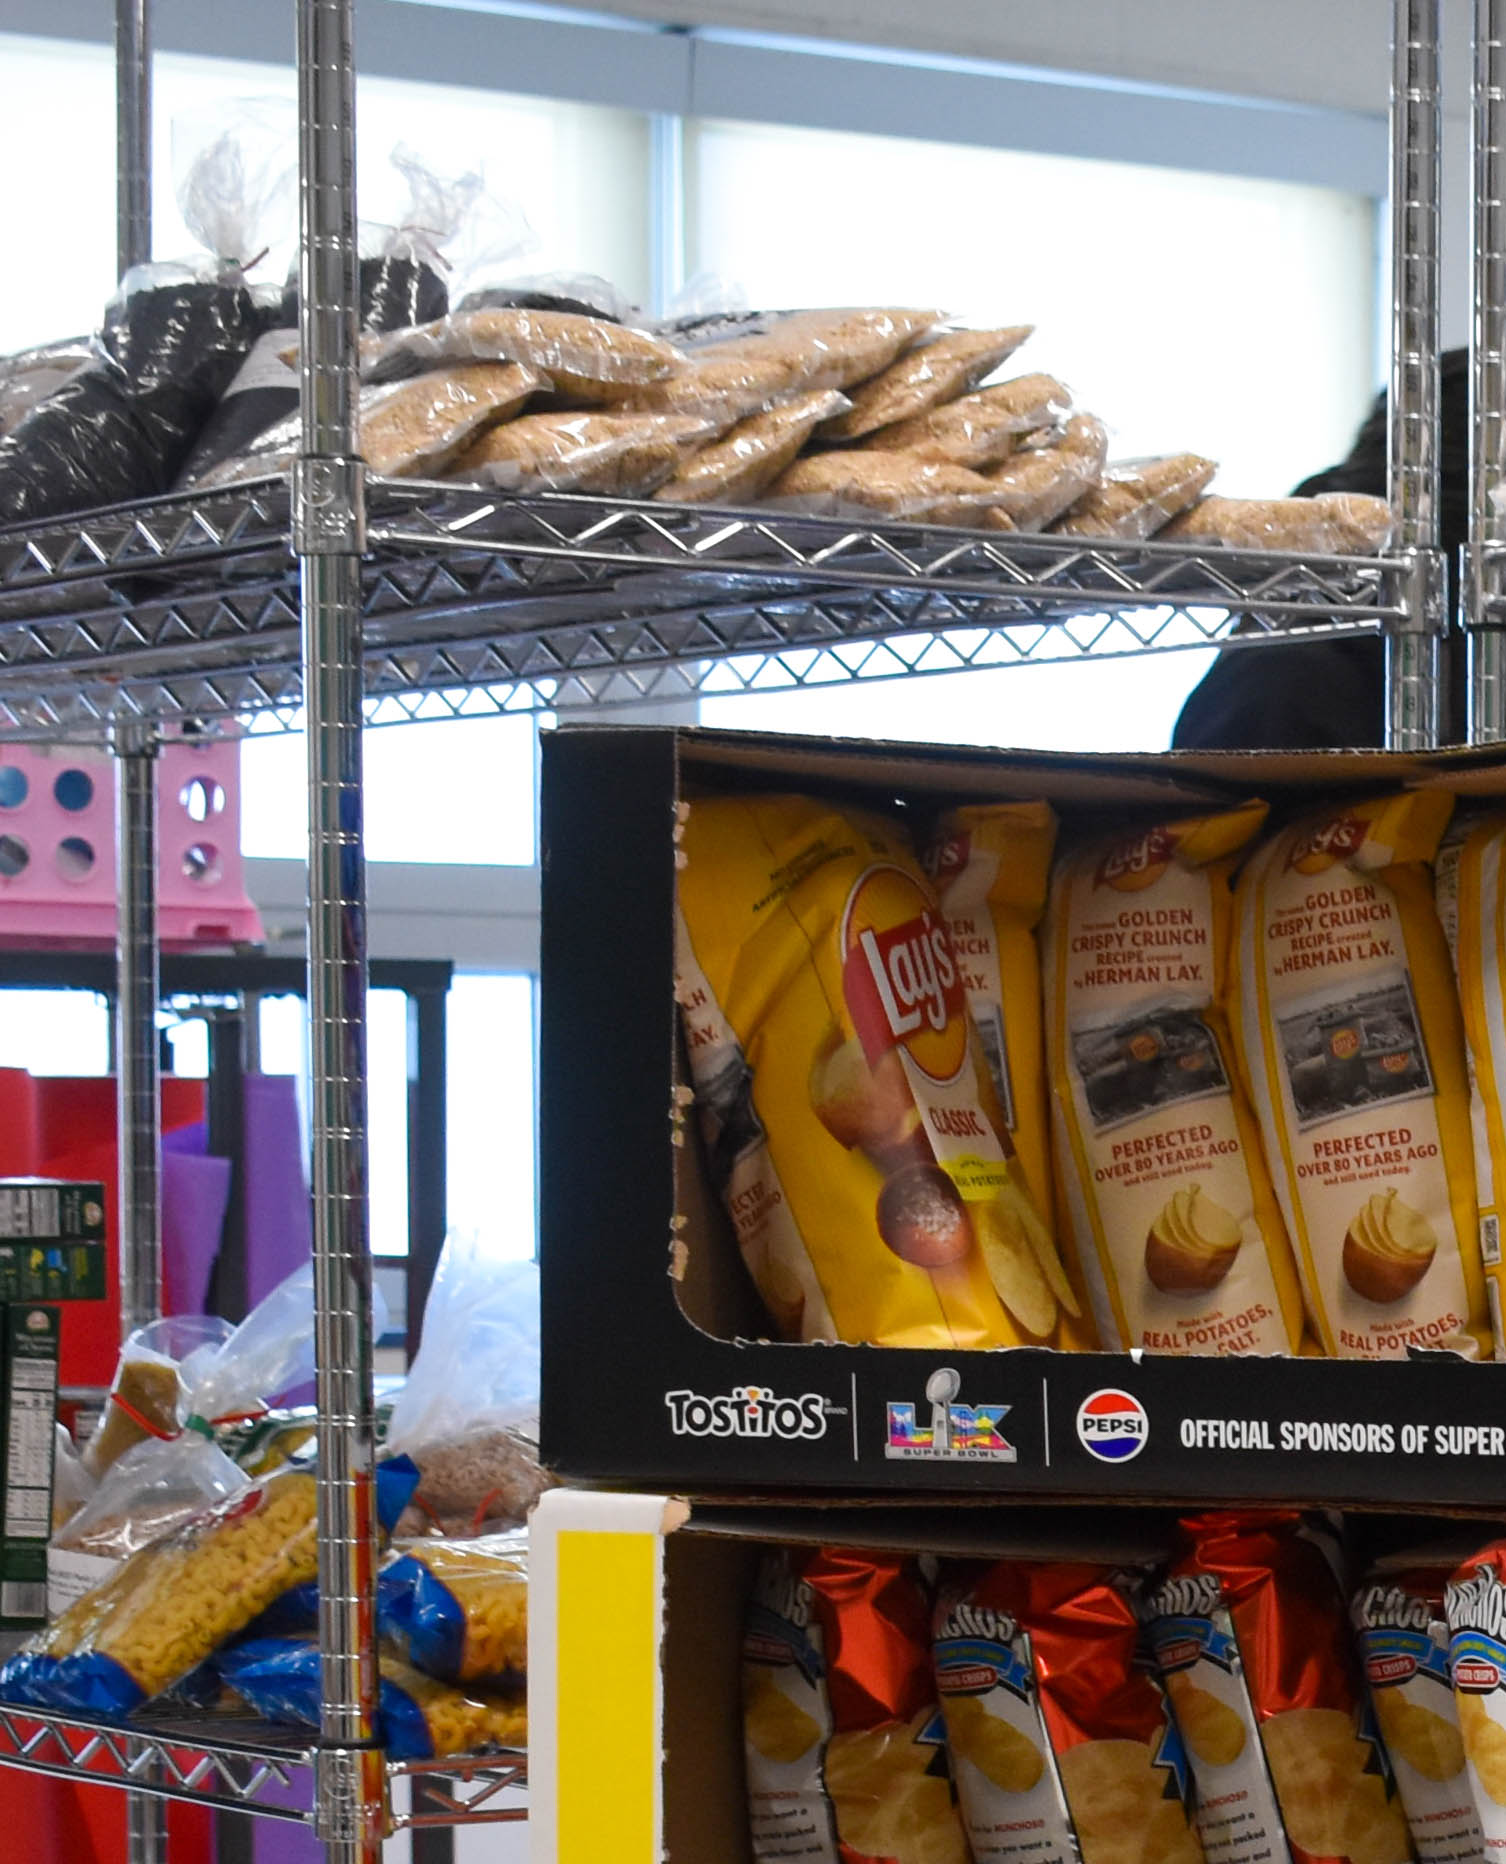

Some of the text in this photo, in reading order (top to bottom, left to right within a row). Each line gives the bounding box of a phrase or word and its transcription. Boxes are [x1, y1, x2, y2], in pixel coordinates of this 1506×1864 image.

[1305, 885, 1376, 911] GOLDEN
[1119, 908, 1193, 928] GOLDEN
[1268, 904, 1392, 940] CRISPY CRUNCH
[1071, 929, 1208, 953] CRISPY CRUNCH
[1282, 940, 1394, 973] HERMAN LAY.
[1291, 932, 1333, 952] RECIPE
[1096, 951, 1144, 965] RECIPE
[859, 912, 956, 1038] Lay's
[1084, 965, 1203, 987] HERMAN LAY.
[928, 1107, 987, 1138] CLASSIC
[1112, 1125, 1213, 1160] PERFECTED
[1313, 1128, 1412, 1158] PERFECTED
[1095, 1139, 1239, 1183] OVER 80 YEARS AGO
[1297, 1144, 1438, 1178] OVER 80 YEARS AGO
[1143, 1303, 1273, 1348] REAL POTATOES,
[1340, 1313, 1464, 1351] REAL POTATOES,
[1082, 1417, 1143, 1434] PEPSI
[1180, 1418, 1275, 1451] OFFICIAL
[1280, 1419, 1396, 1453] SPONSORS
[1401, 1422, 1428, 1454] OF
[1434, 1424, 1505, 1456] SUPER
[903, 1447, 999, 1460] SUPER BOWL
